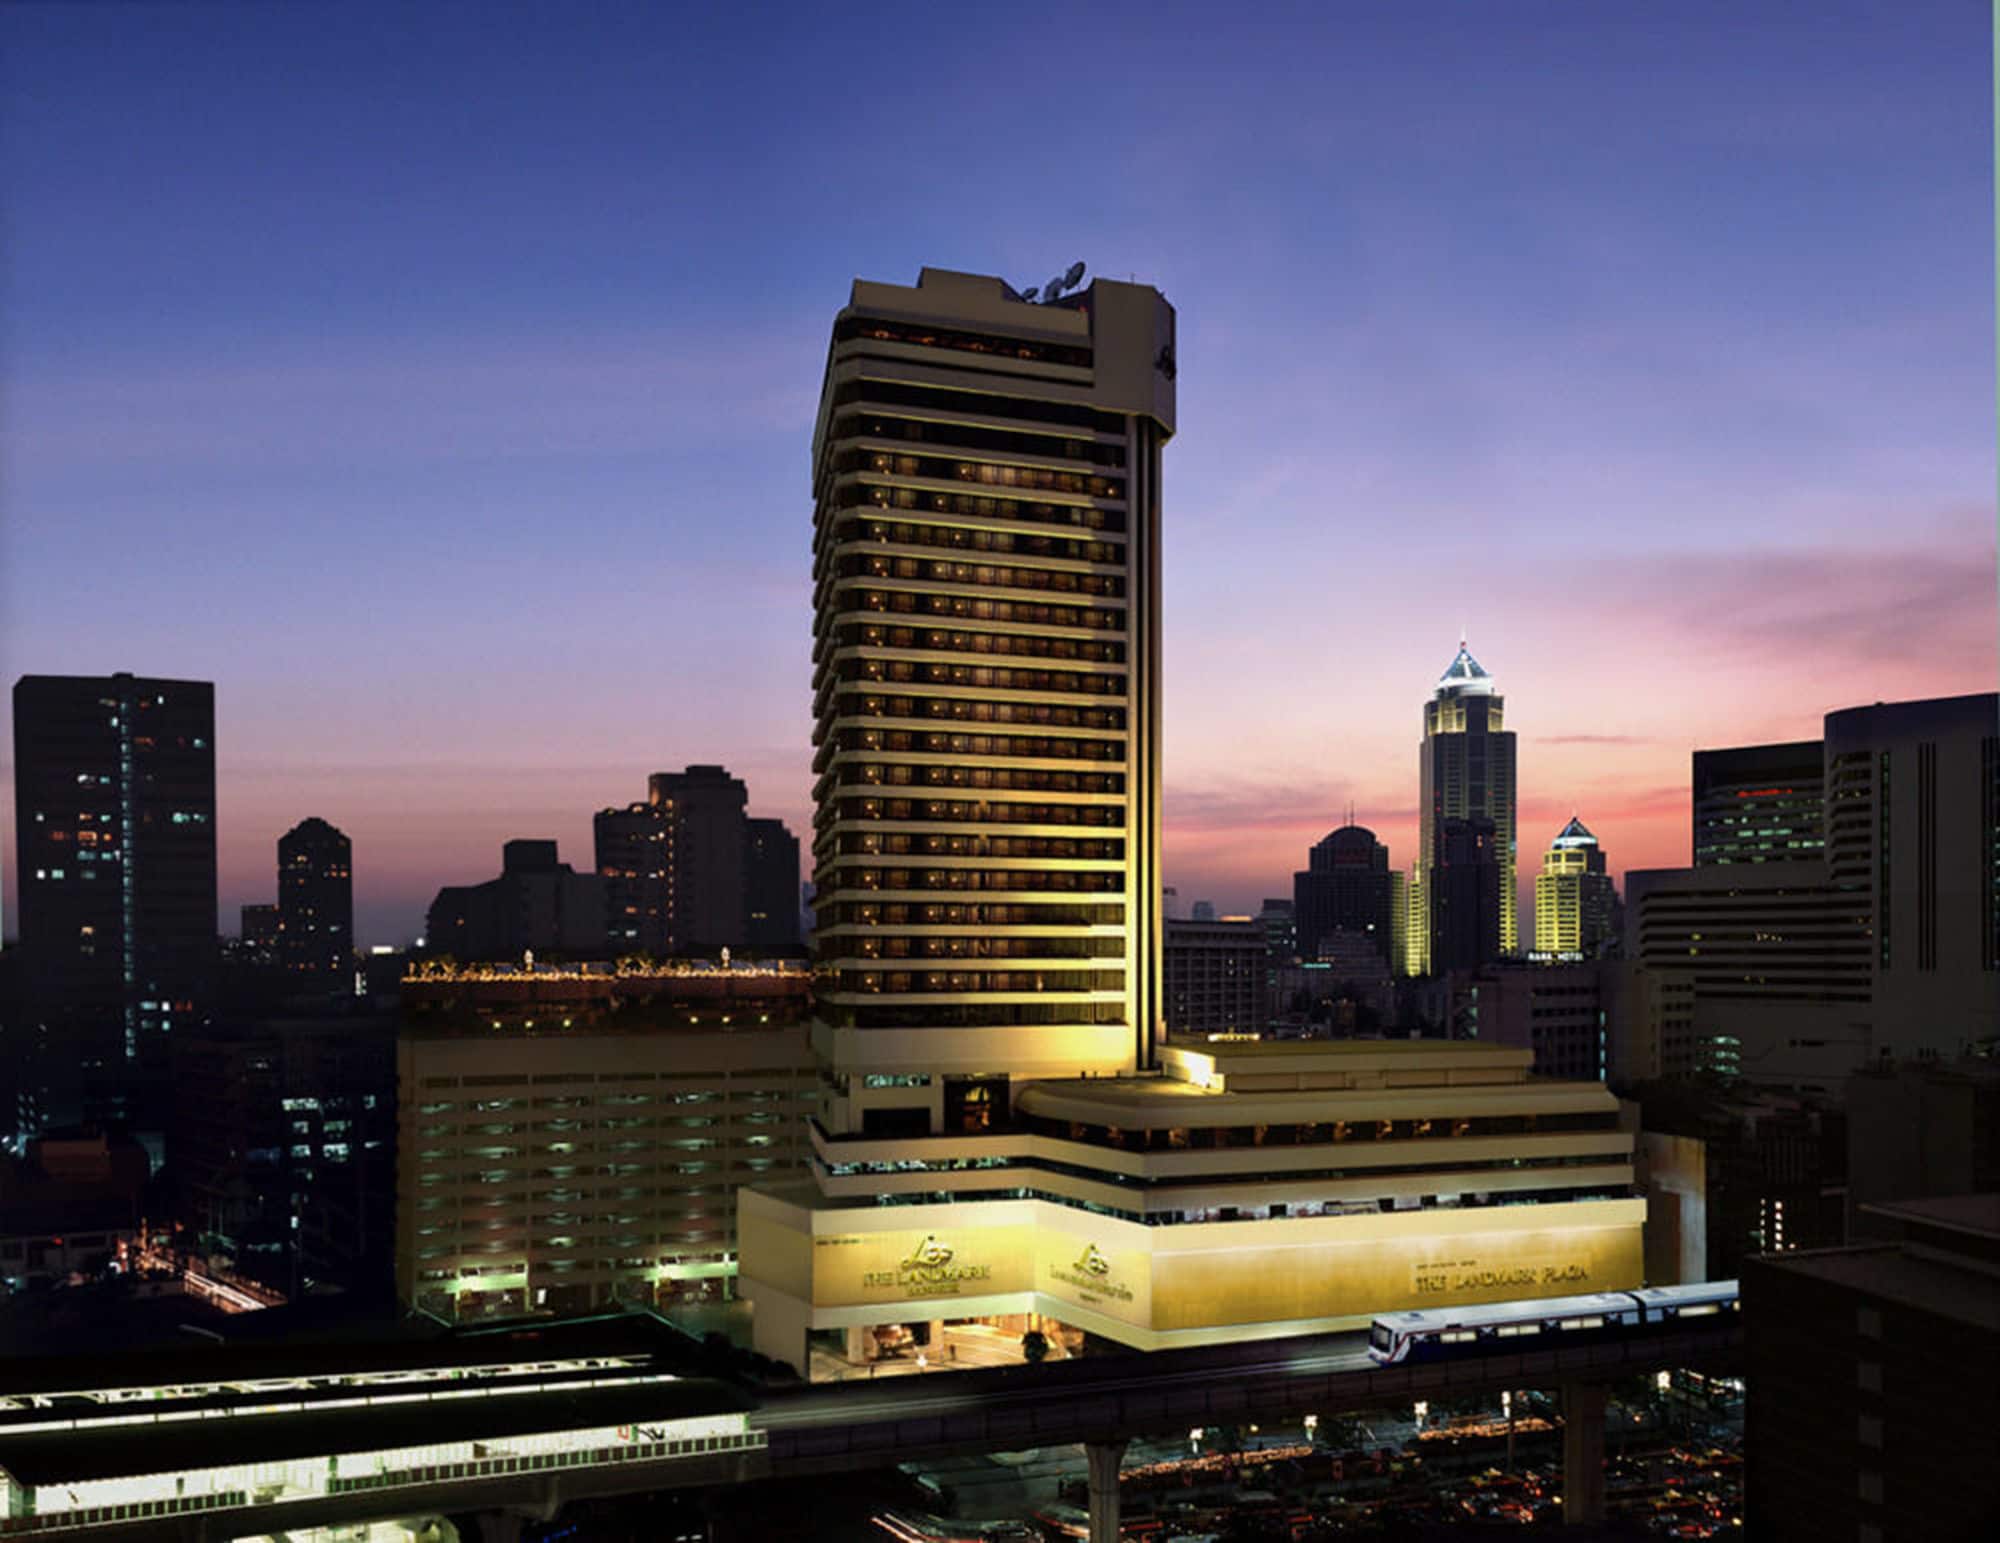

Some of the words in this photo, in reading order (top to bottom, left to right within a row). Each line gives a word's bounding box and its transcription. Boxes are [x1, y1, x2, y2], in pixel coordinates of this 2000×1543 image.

[863, 1271, 893, 1288] THE
[897, 1264, 991, 1286] LANDMARK
[1416, 1274, 1447, 1293] THE
[1455, 1267, 1536, 1290] LANDMARK
